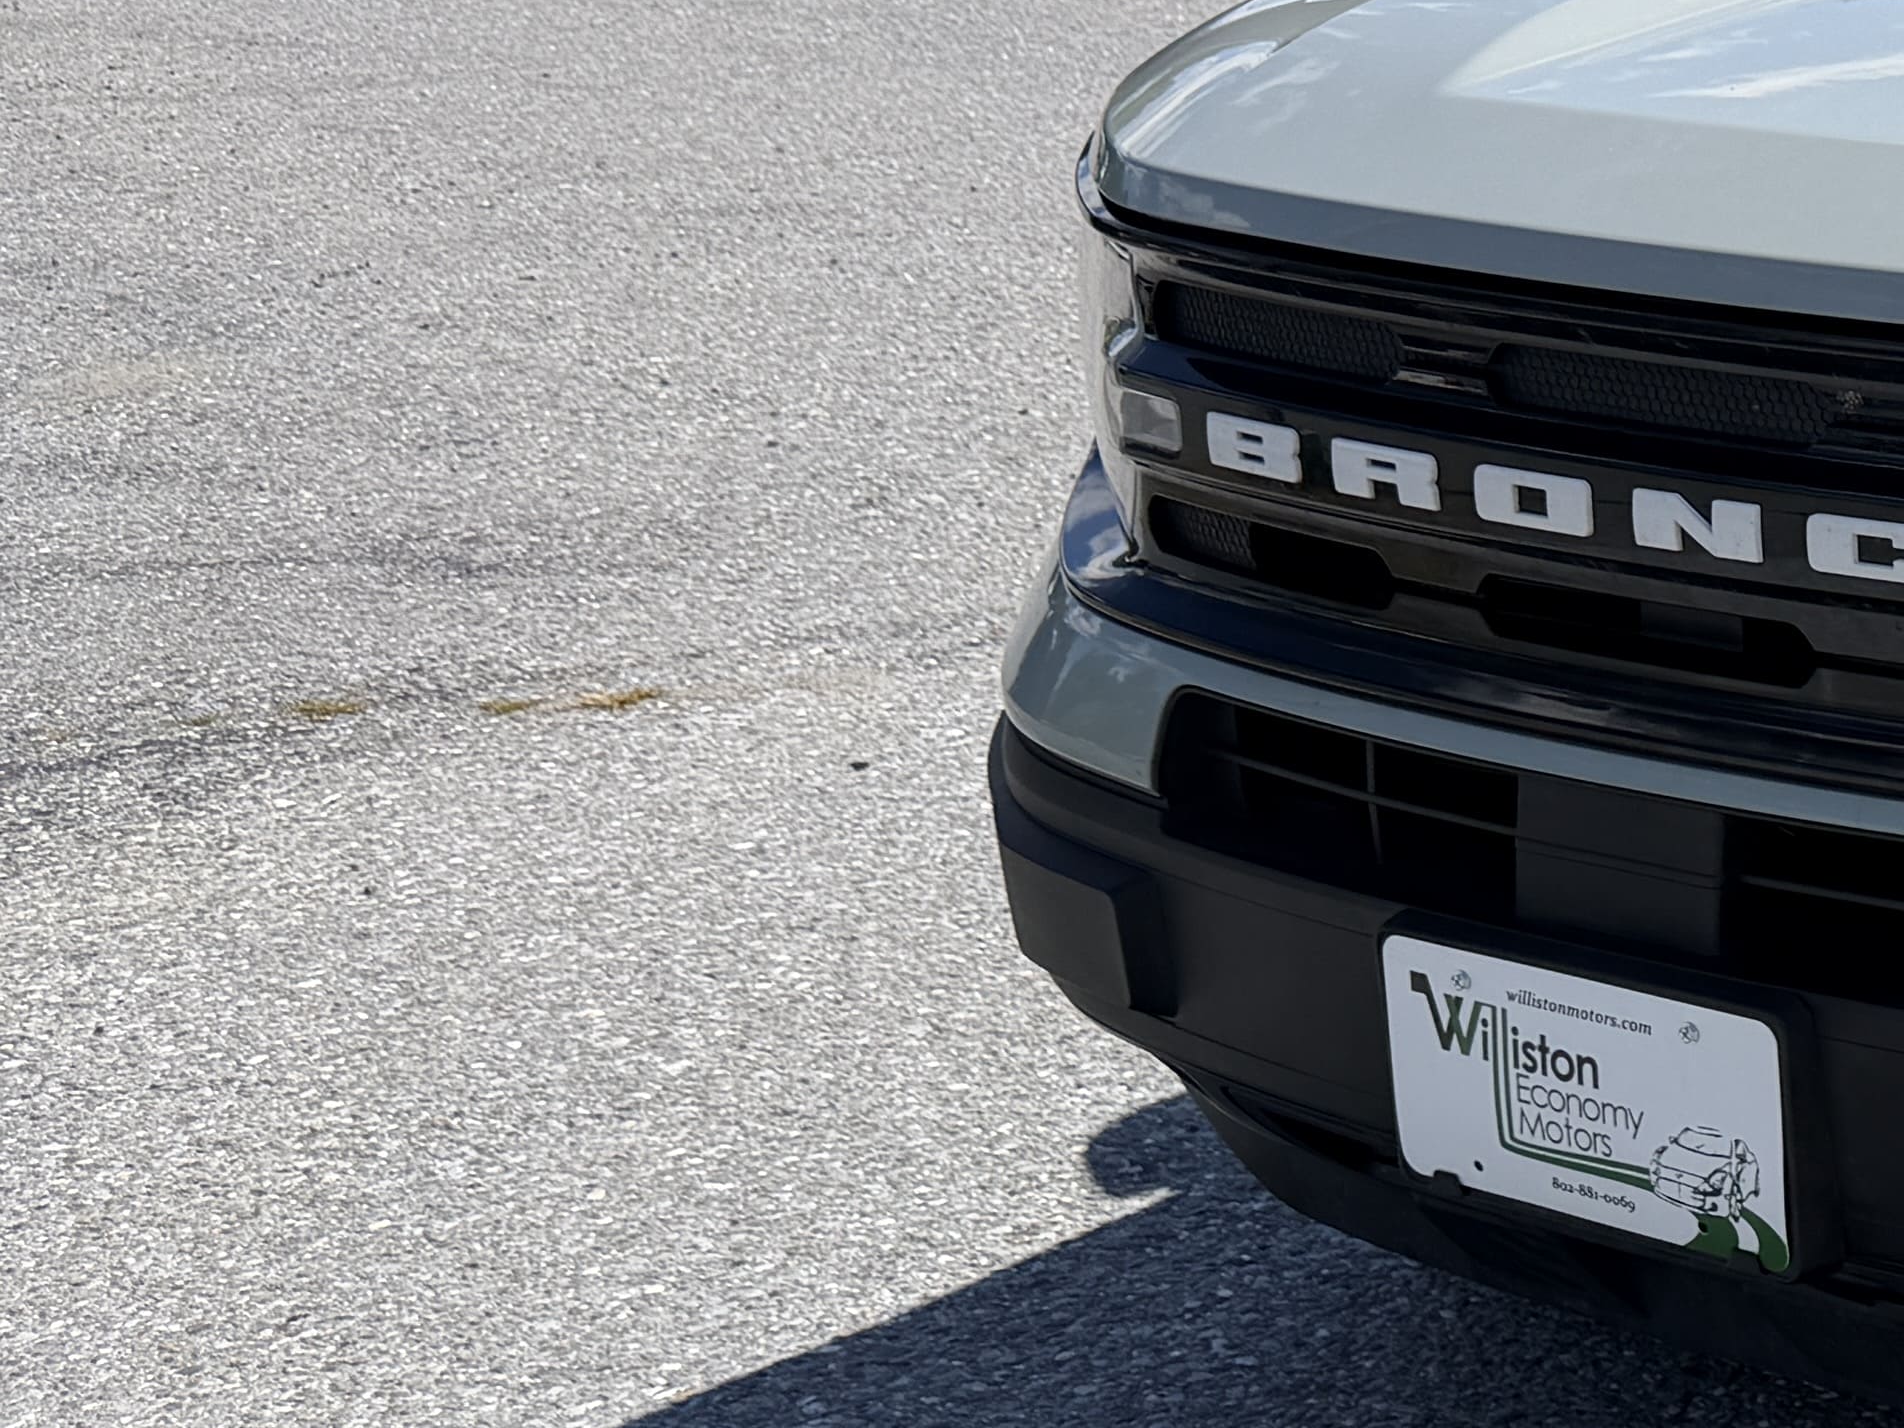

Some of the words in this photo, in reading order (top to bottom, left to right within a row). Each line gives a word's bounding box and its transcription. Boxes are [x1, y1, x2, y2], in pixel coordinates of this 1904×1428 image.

[1409, 970, 1600, 1090] Williston
[1505, 989, 1653, 1036] willistonmotors.com
[1515, 1072, 1645, 1139] Economy
[1519, 1107, 1613, 1158] Motors
[1551, 1176, 1636, 1213] 802-881-0069
